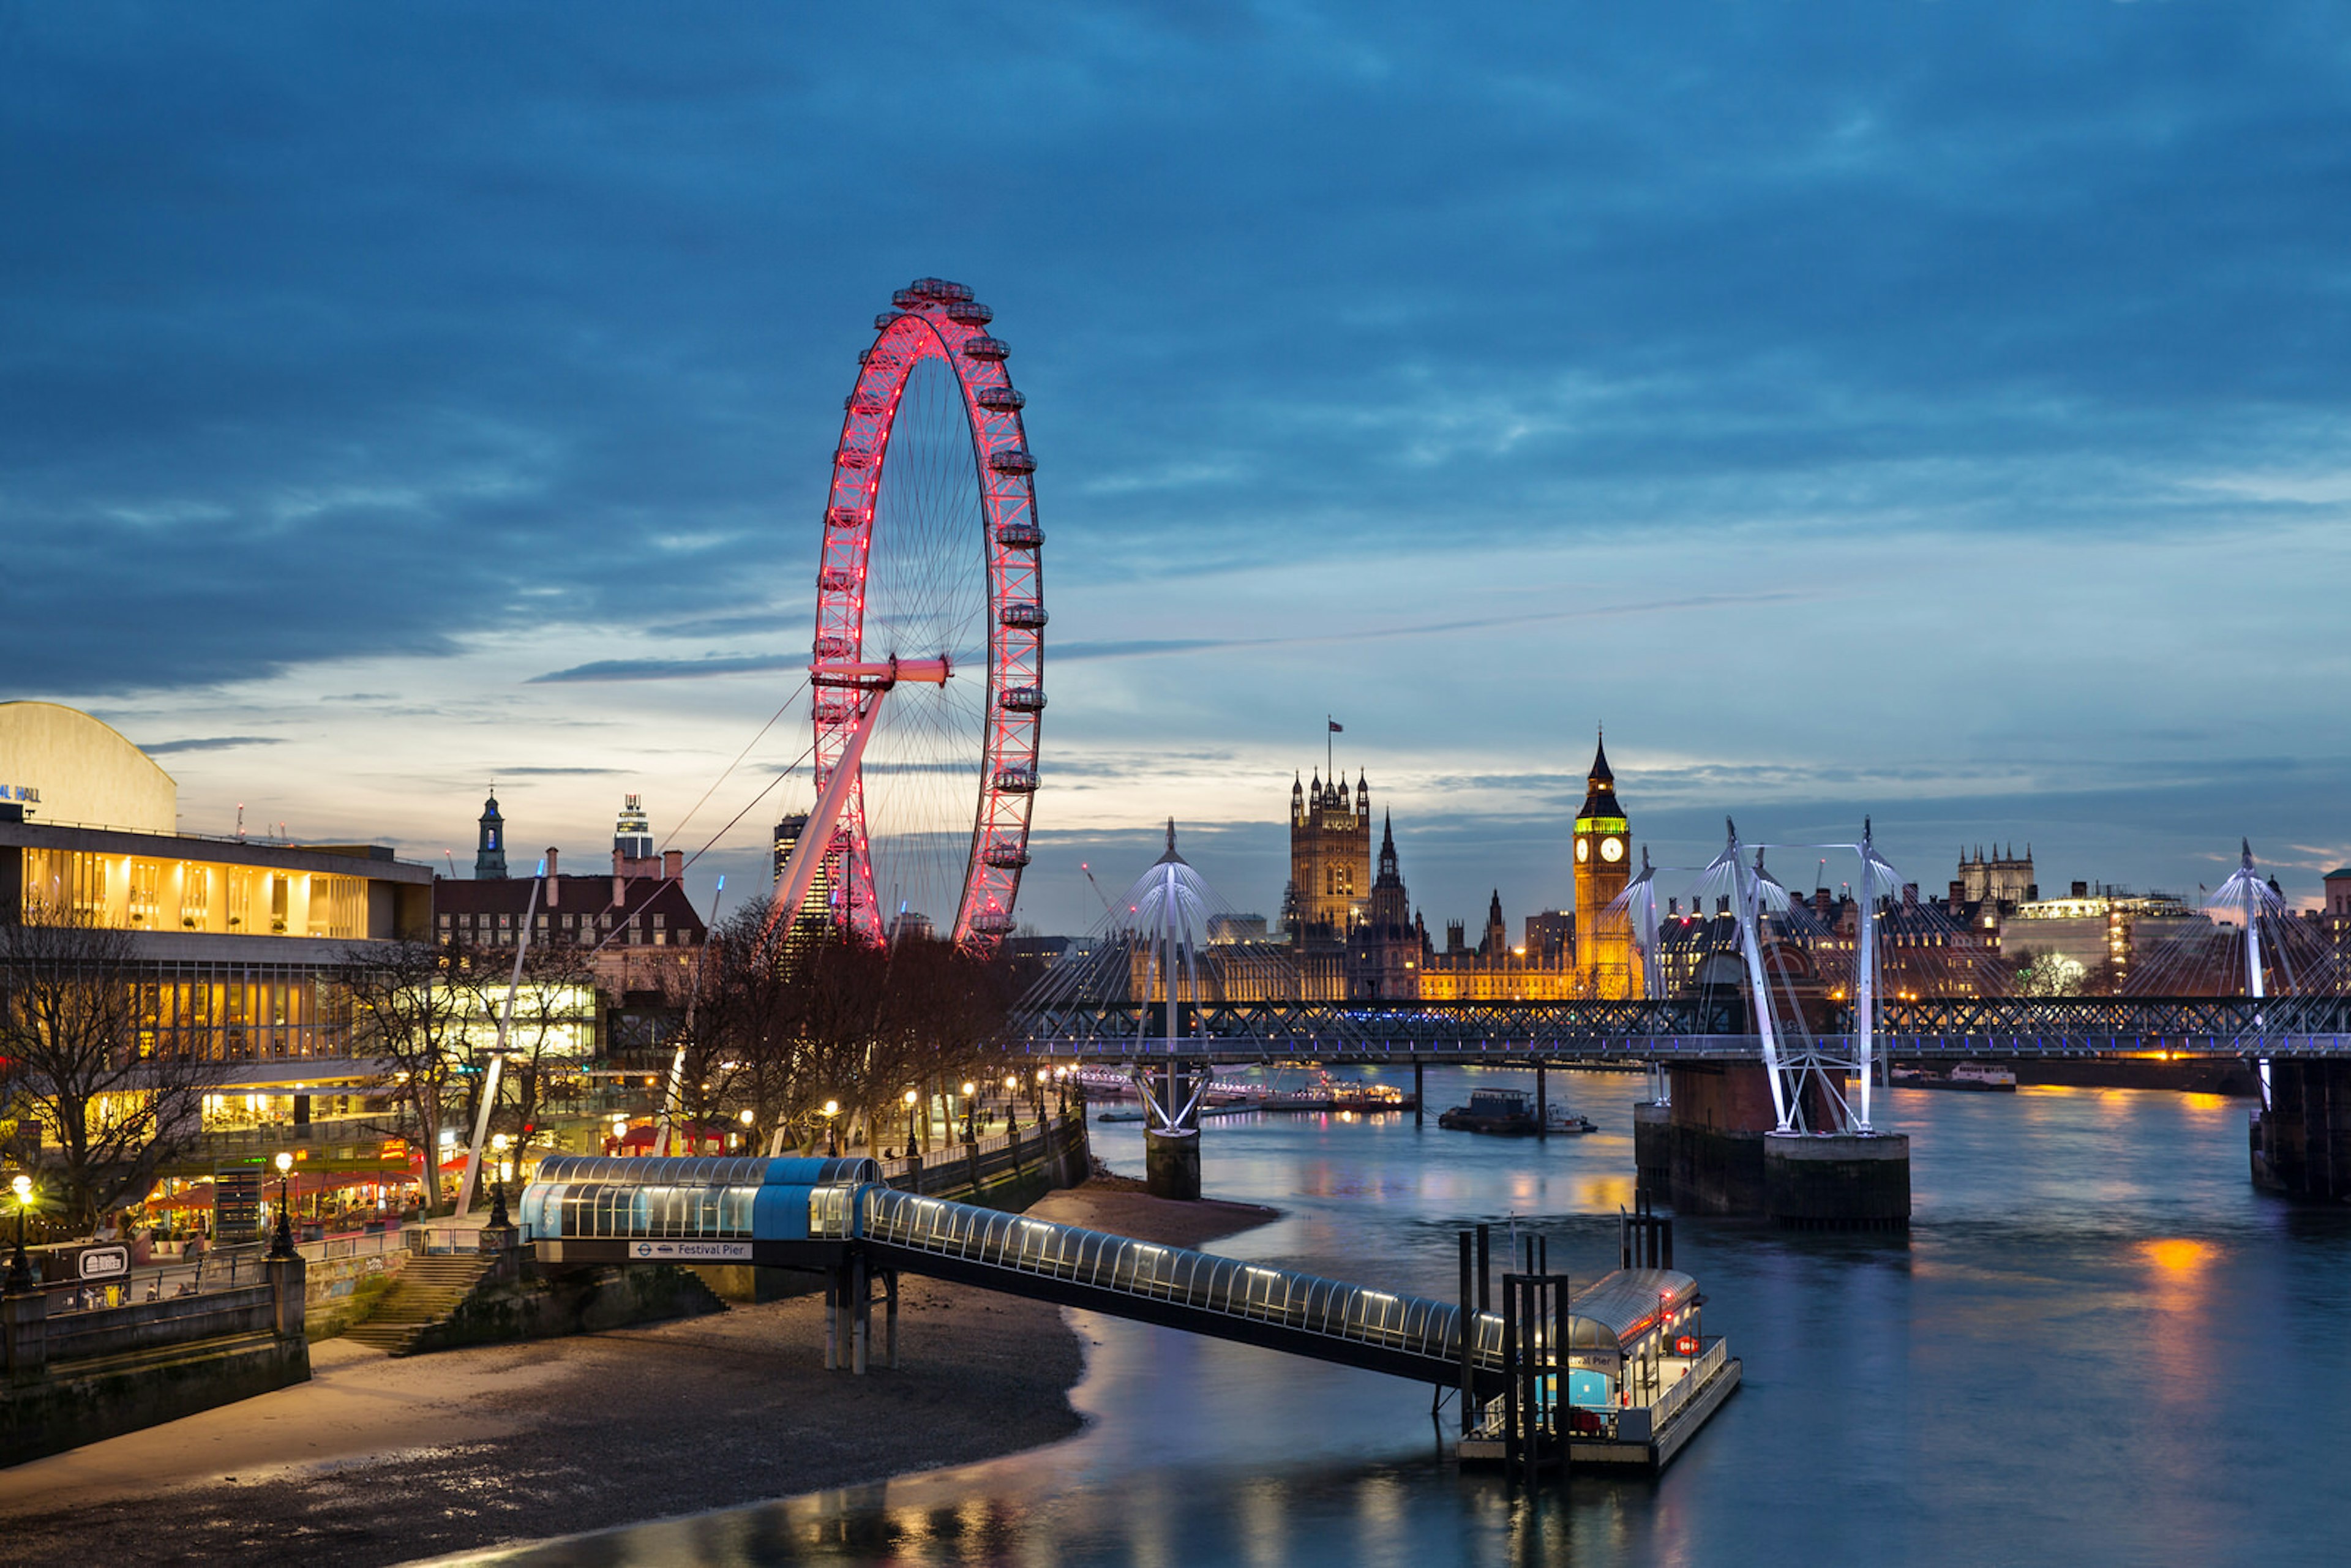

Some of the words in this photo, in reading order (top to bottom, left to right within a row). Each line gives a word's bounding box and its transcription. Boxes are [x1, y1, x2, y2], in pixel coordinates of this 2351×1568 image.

[15, 786, 41, 803] HALL
[679, 1244, 719, 1254] Festival
[723, 1244, 744, 1255] Pier
[1593, 1356, 1611, 1365] Pier
